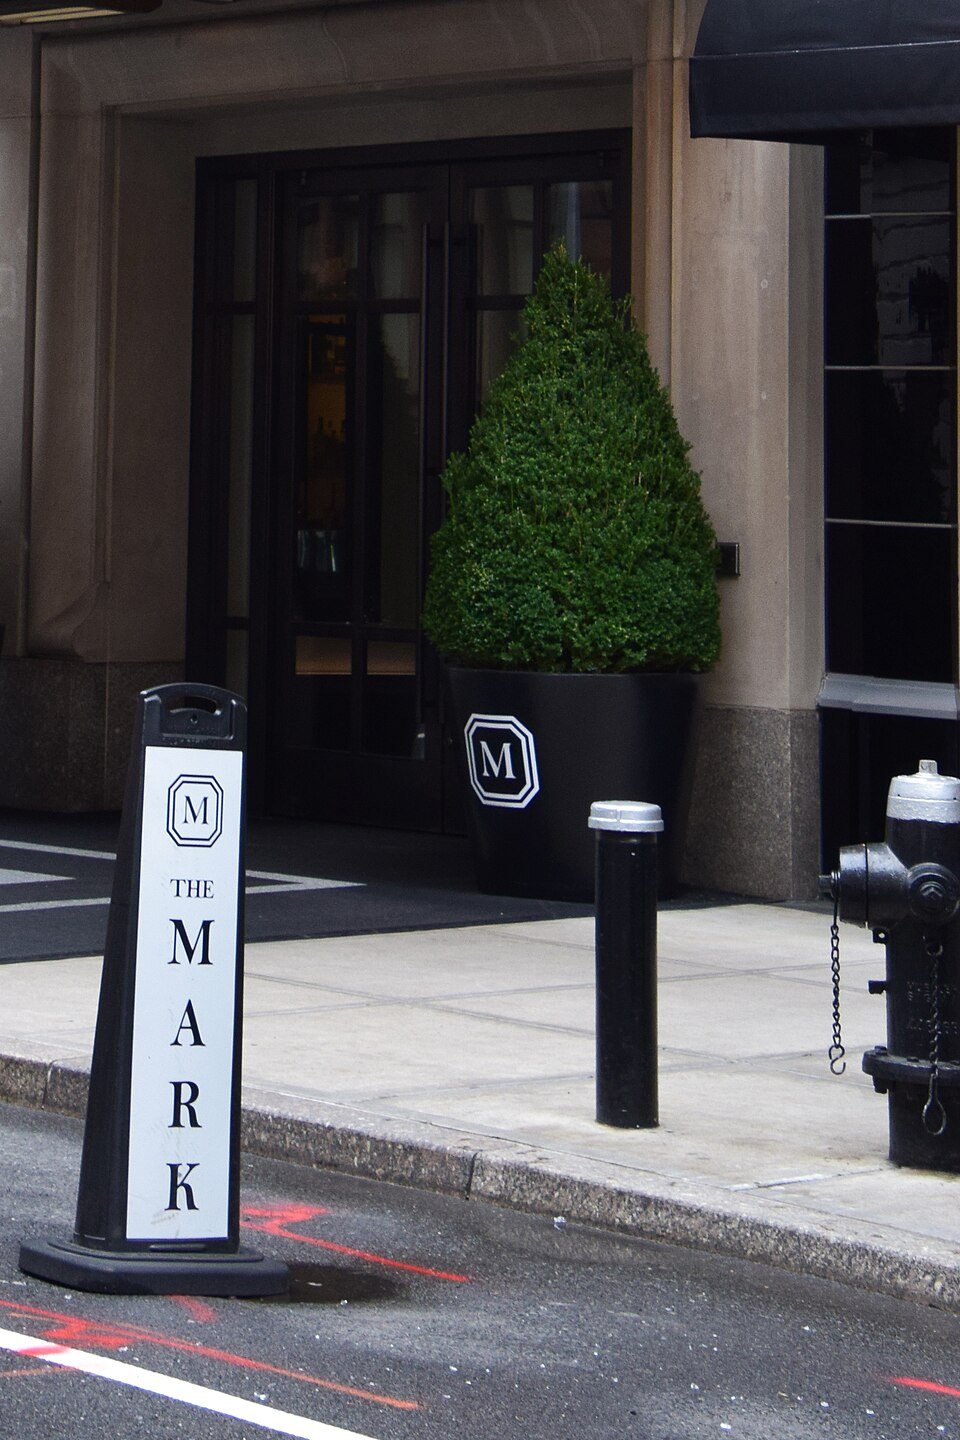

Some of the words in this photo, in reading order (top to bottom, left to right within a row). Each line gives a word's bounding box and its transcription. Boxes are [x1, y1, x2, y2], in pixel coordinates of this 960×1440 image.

[480, 740, 517, 779] M
[182, 795, 209, 825] M
[170, 878, 215, 899] THE
[164, 918, 215, 1211] MARK
